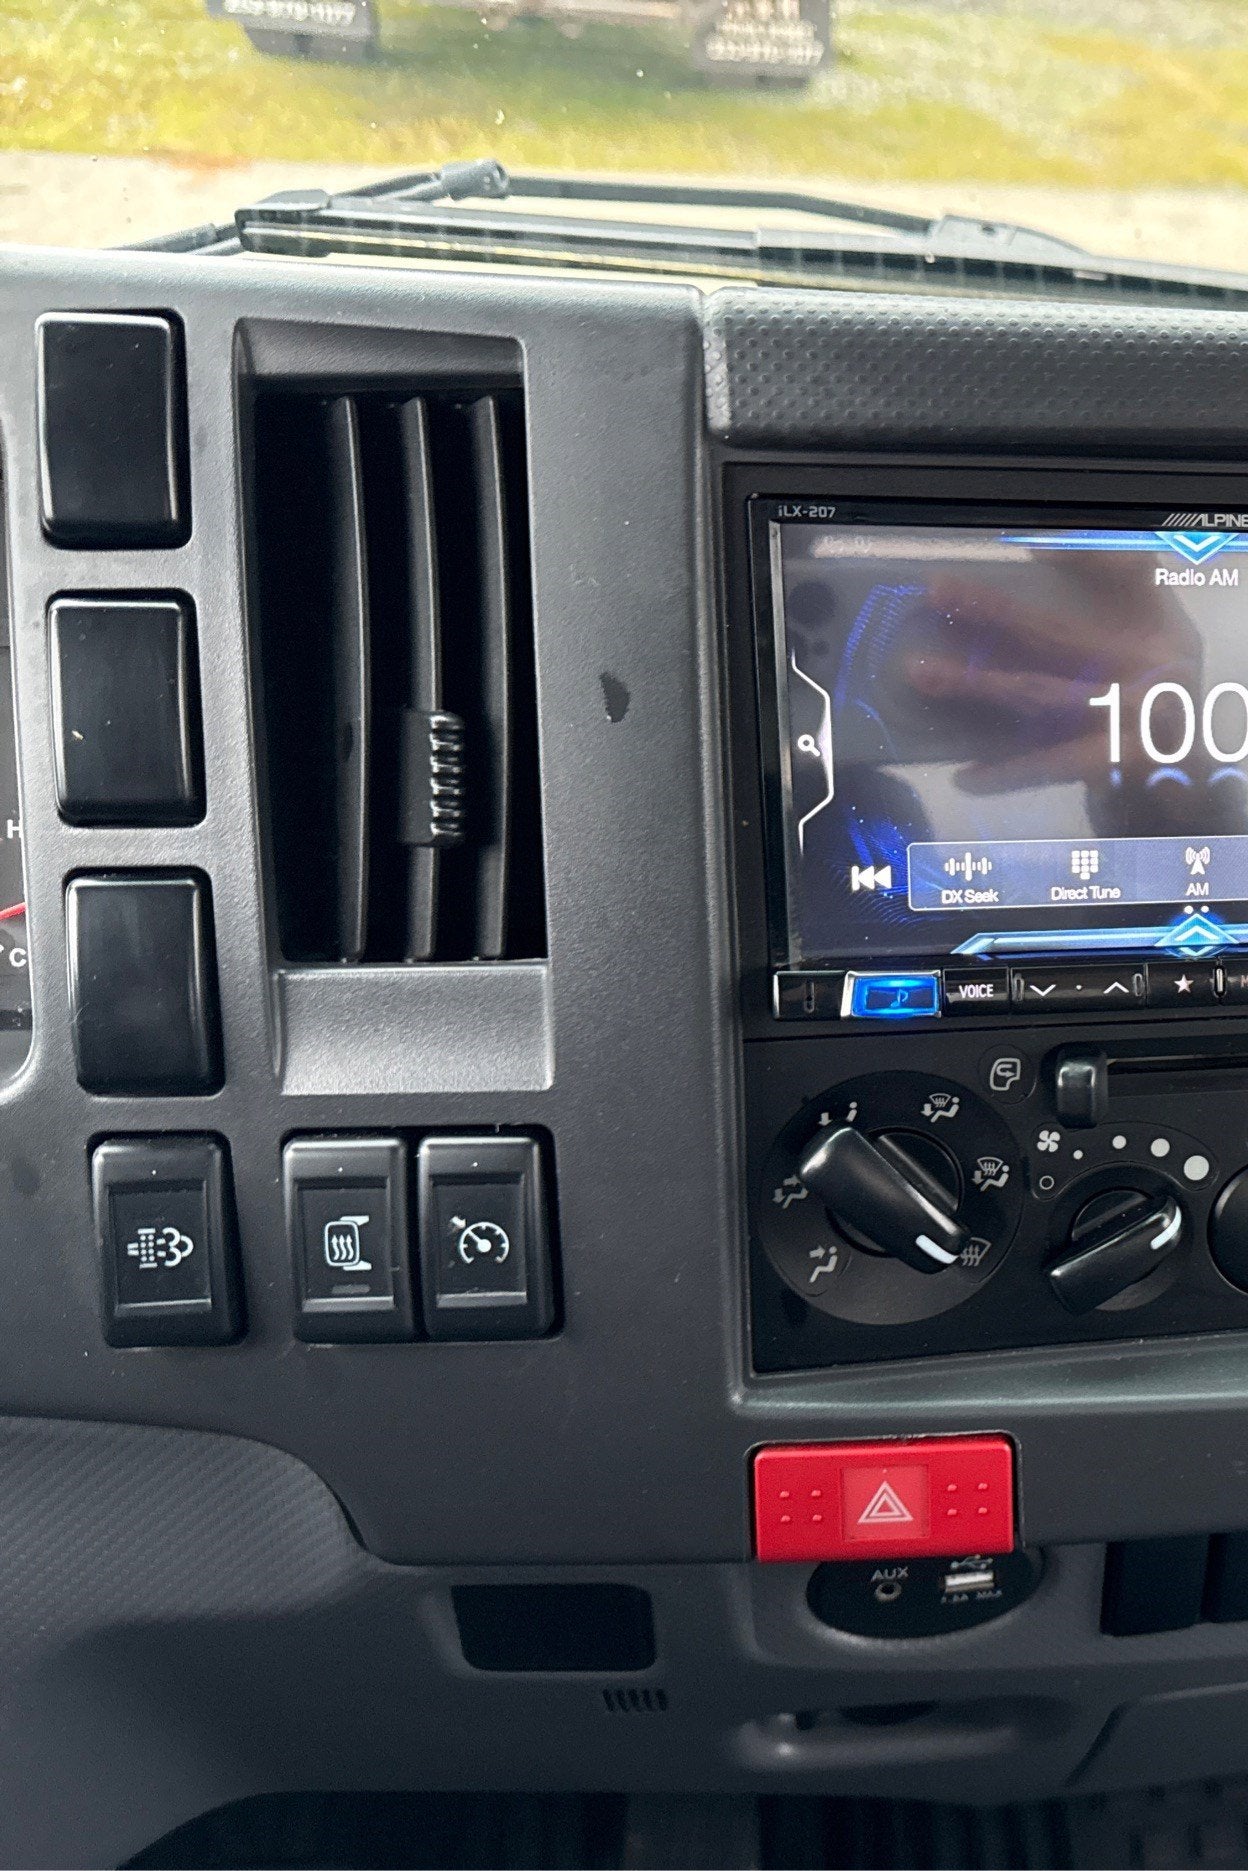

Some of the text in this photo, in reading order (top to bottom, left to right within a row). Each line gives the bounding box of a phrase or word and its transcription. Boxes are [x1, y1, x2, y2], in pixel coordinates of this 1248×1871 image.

[778, 505, 836, 518] iLX-207
[1154, 567, 1239, 587] Radio AM
[941, 889, 1000, 904] DX Seek
[1051, 885, 1121, 901] Direct Tune
[1185, 882, 1209, 896] AM
[9, 947, 27, 967] C
[958, 983, 995, 999] VOICE
[870, 1566, 910, 1582] AUX
